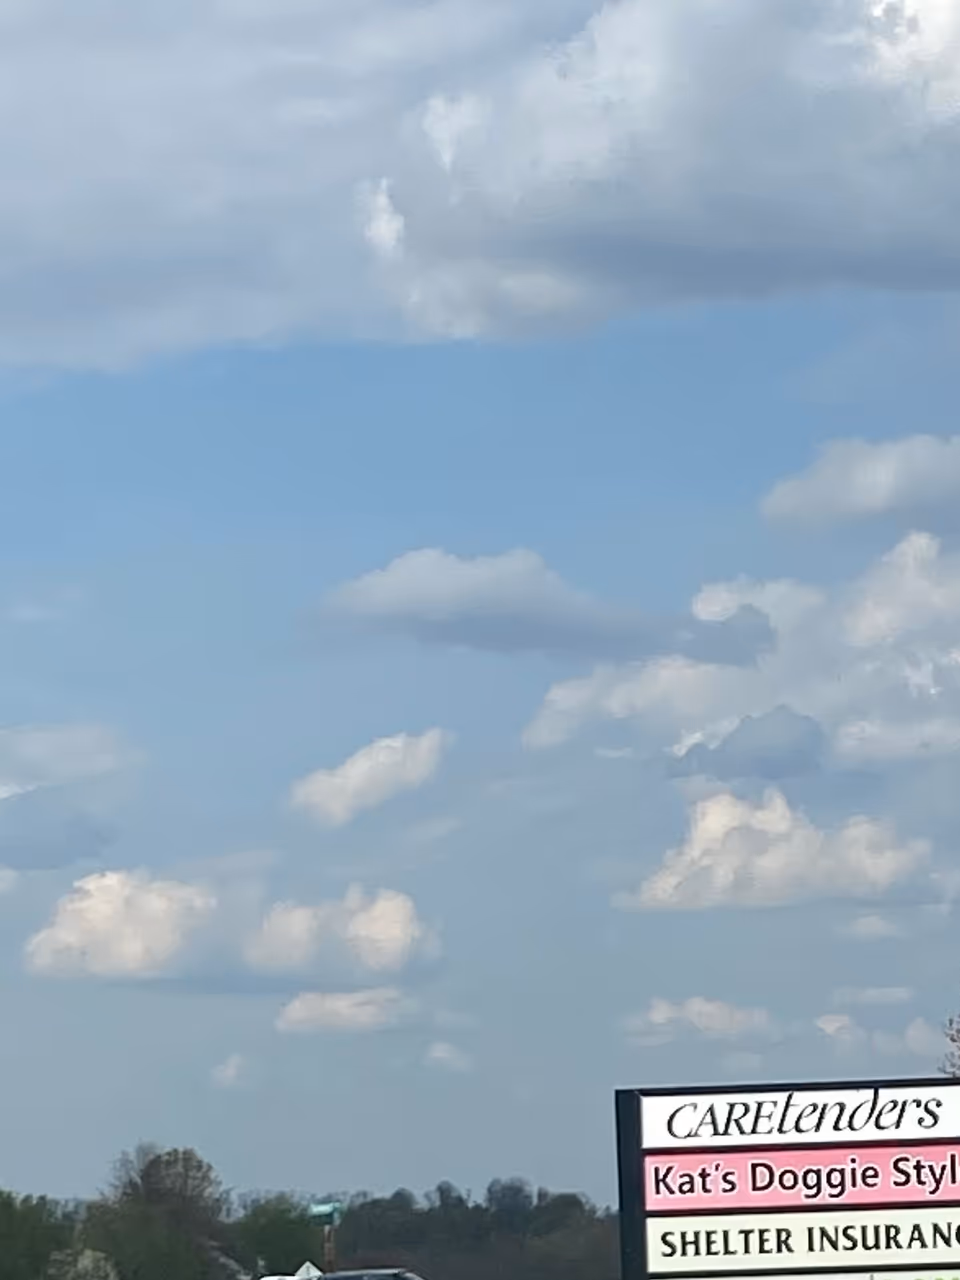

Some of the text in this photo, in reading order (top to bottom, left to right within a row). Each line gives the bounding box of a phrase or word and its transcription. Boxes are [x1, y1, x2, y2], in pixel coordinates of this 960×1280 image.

[667, 1088, 943, 1139] CAREtenders
[653, 1163, 738, 1196] Kat's
[750, 1157, 881, 1199] Doggie
[660, 1227, 795, 1258] SHELTER
